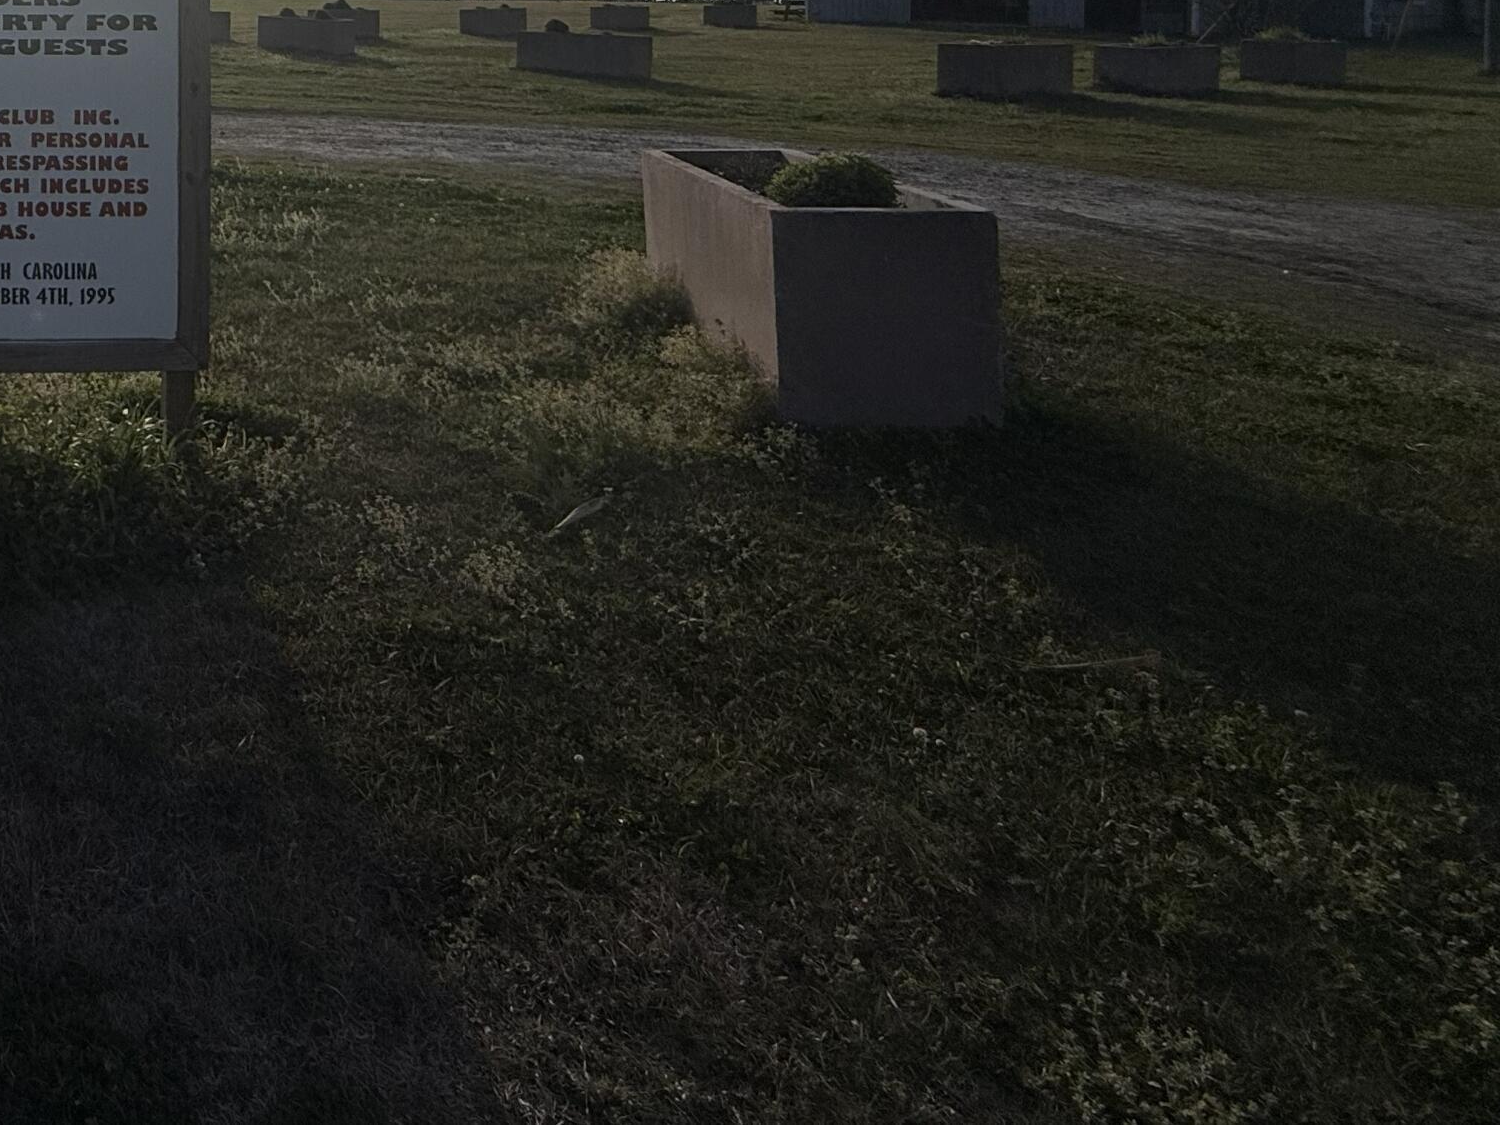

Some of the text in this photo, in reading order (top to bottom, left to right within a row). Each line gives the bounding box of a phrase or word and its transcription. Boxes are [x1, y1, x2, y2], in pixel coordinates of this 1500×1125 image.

[87, 15, 157, 31] FOR
[75, 110, 119, 125] INC.
[32, 133, 149, 148] PERSONAL
[41, 178, 148, 194] INCLUDES
[18, 202, 91, 217] HOUSE
[99, 202, 147, 217] AND
[23, 263, 97, 280] CAROLINA
[37, 288, 72, 306] 4TH,
[80, 288, 114, 304] 1995
